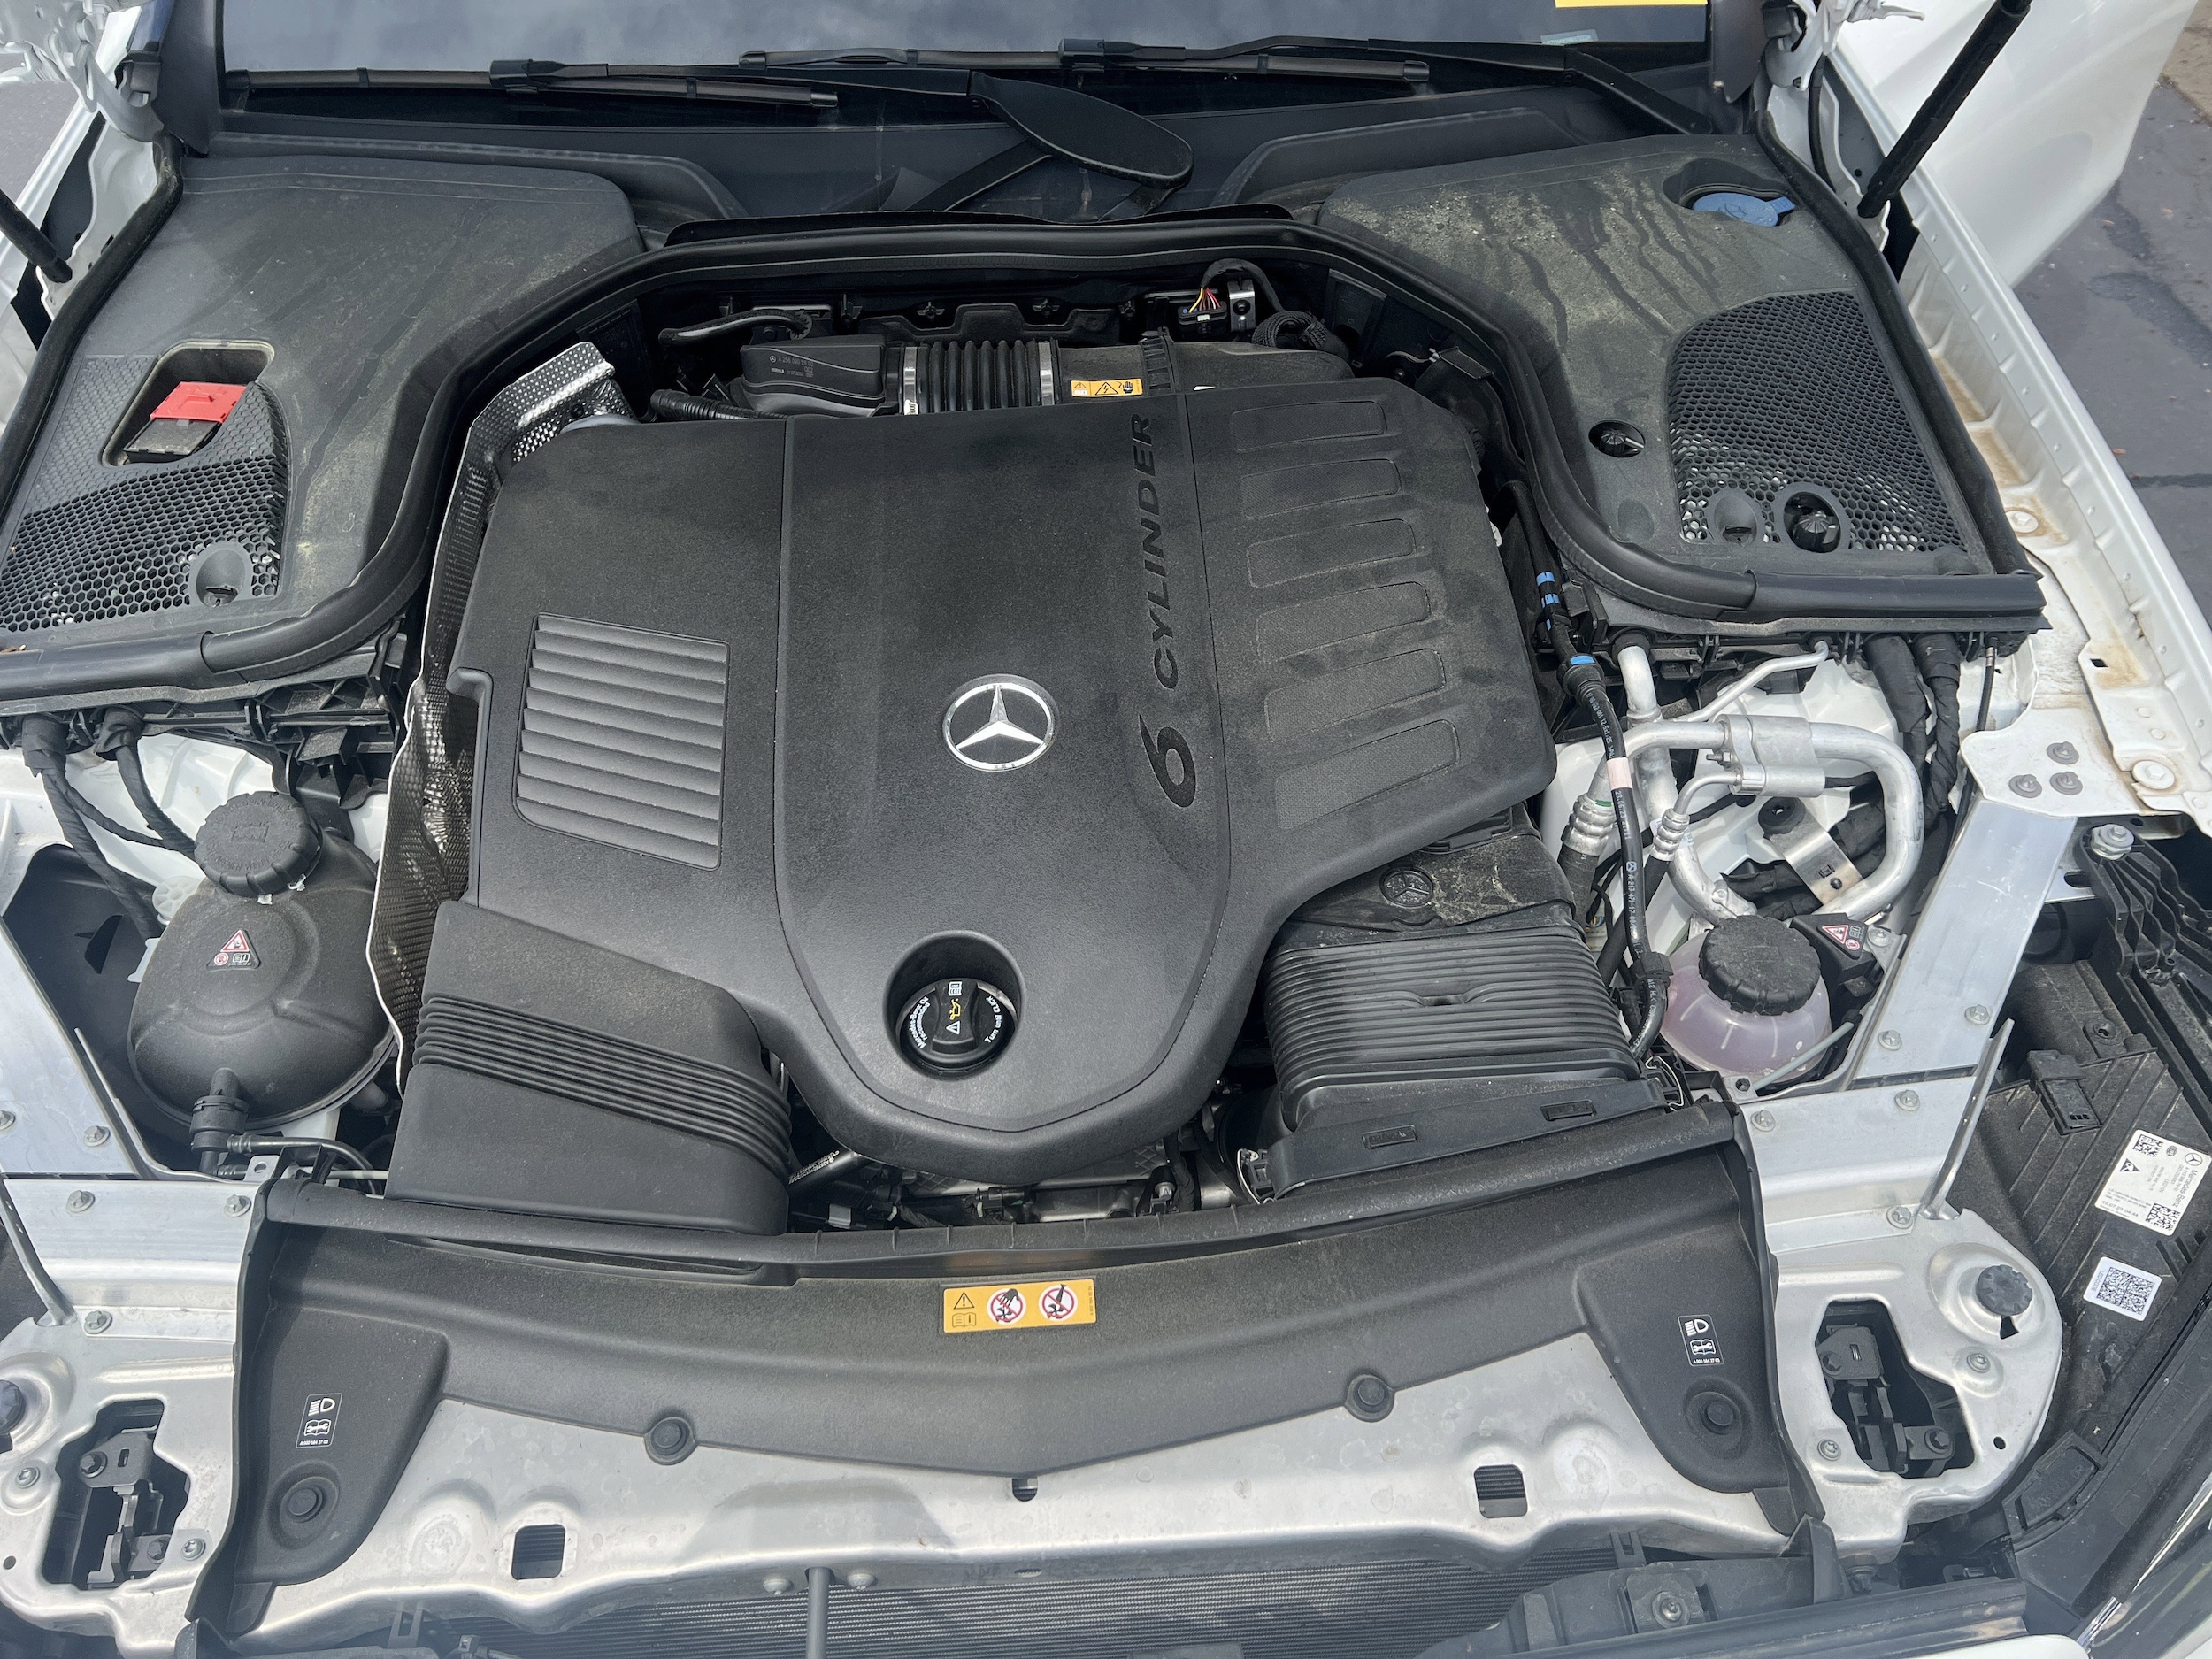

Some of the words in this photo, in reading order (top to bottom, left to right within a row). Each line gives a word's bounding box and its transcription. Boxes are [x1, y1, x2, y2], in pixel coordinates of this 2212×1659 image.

[1131, 413, 1179, 689] CYLINDER
[1139, 714, 1196, 808] 6
[1627, 880, 1636, 892] 213
[917, 1002, 931, 1041] recommended
[985, 995, 1001, 1013] CLICK
[909, 1003, 926, 1049] Mercedes-Benz
[984, 1029, 999, 1043] Turn
[2172, 1170, 2198, 1208] Mercedes-Benz
